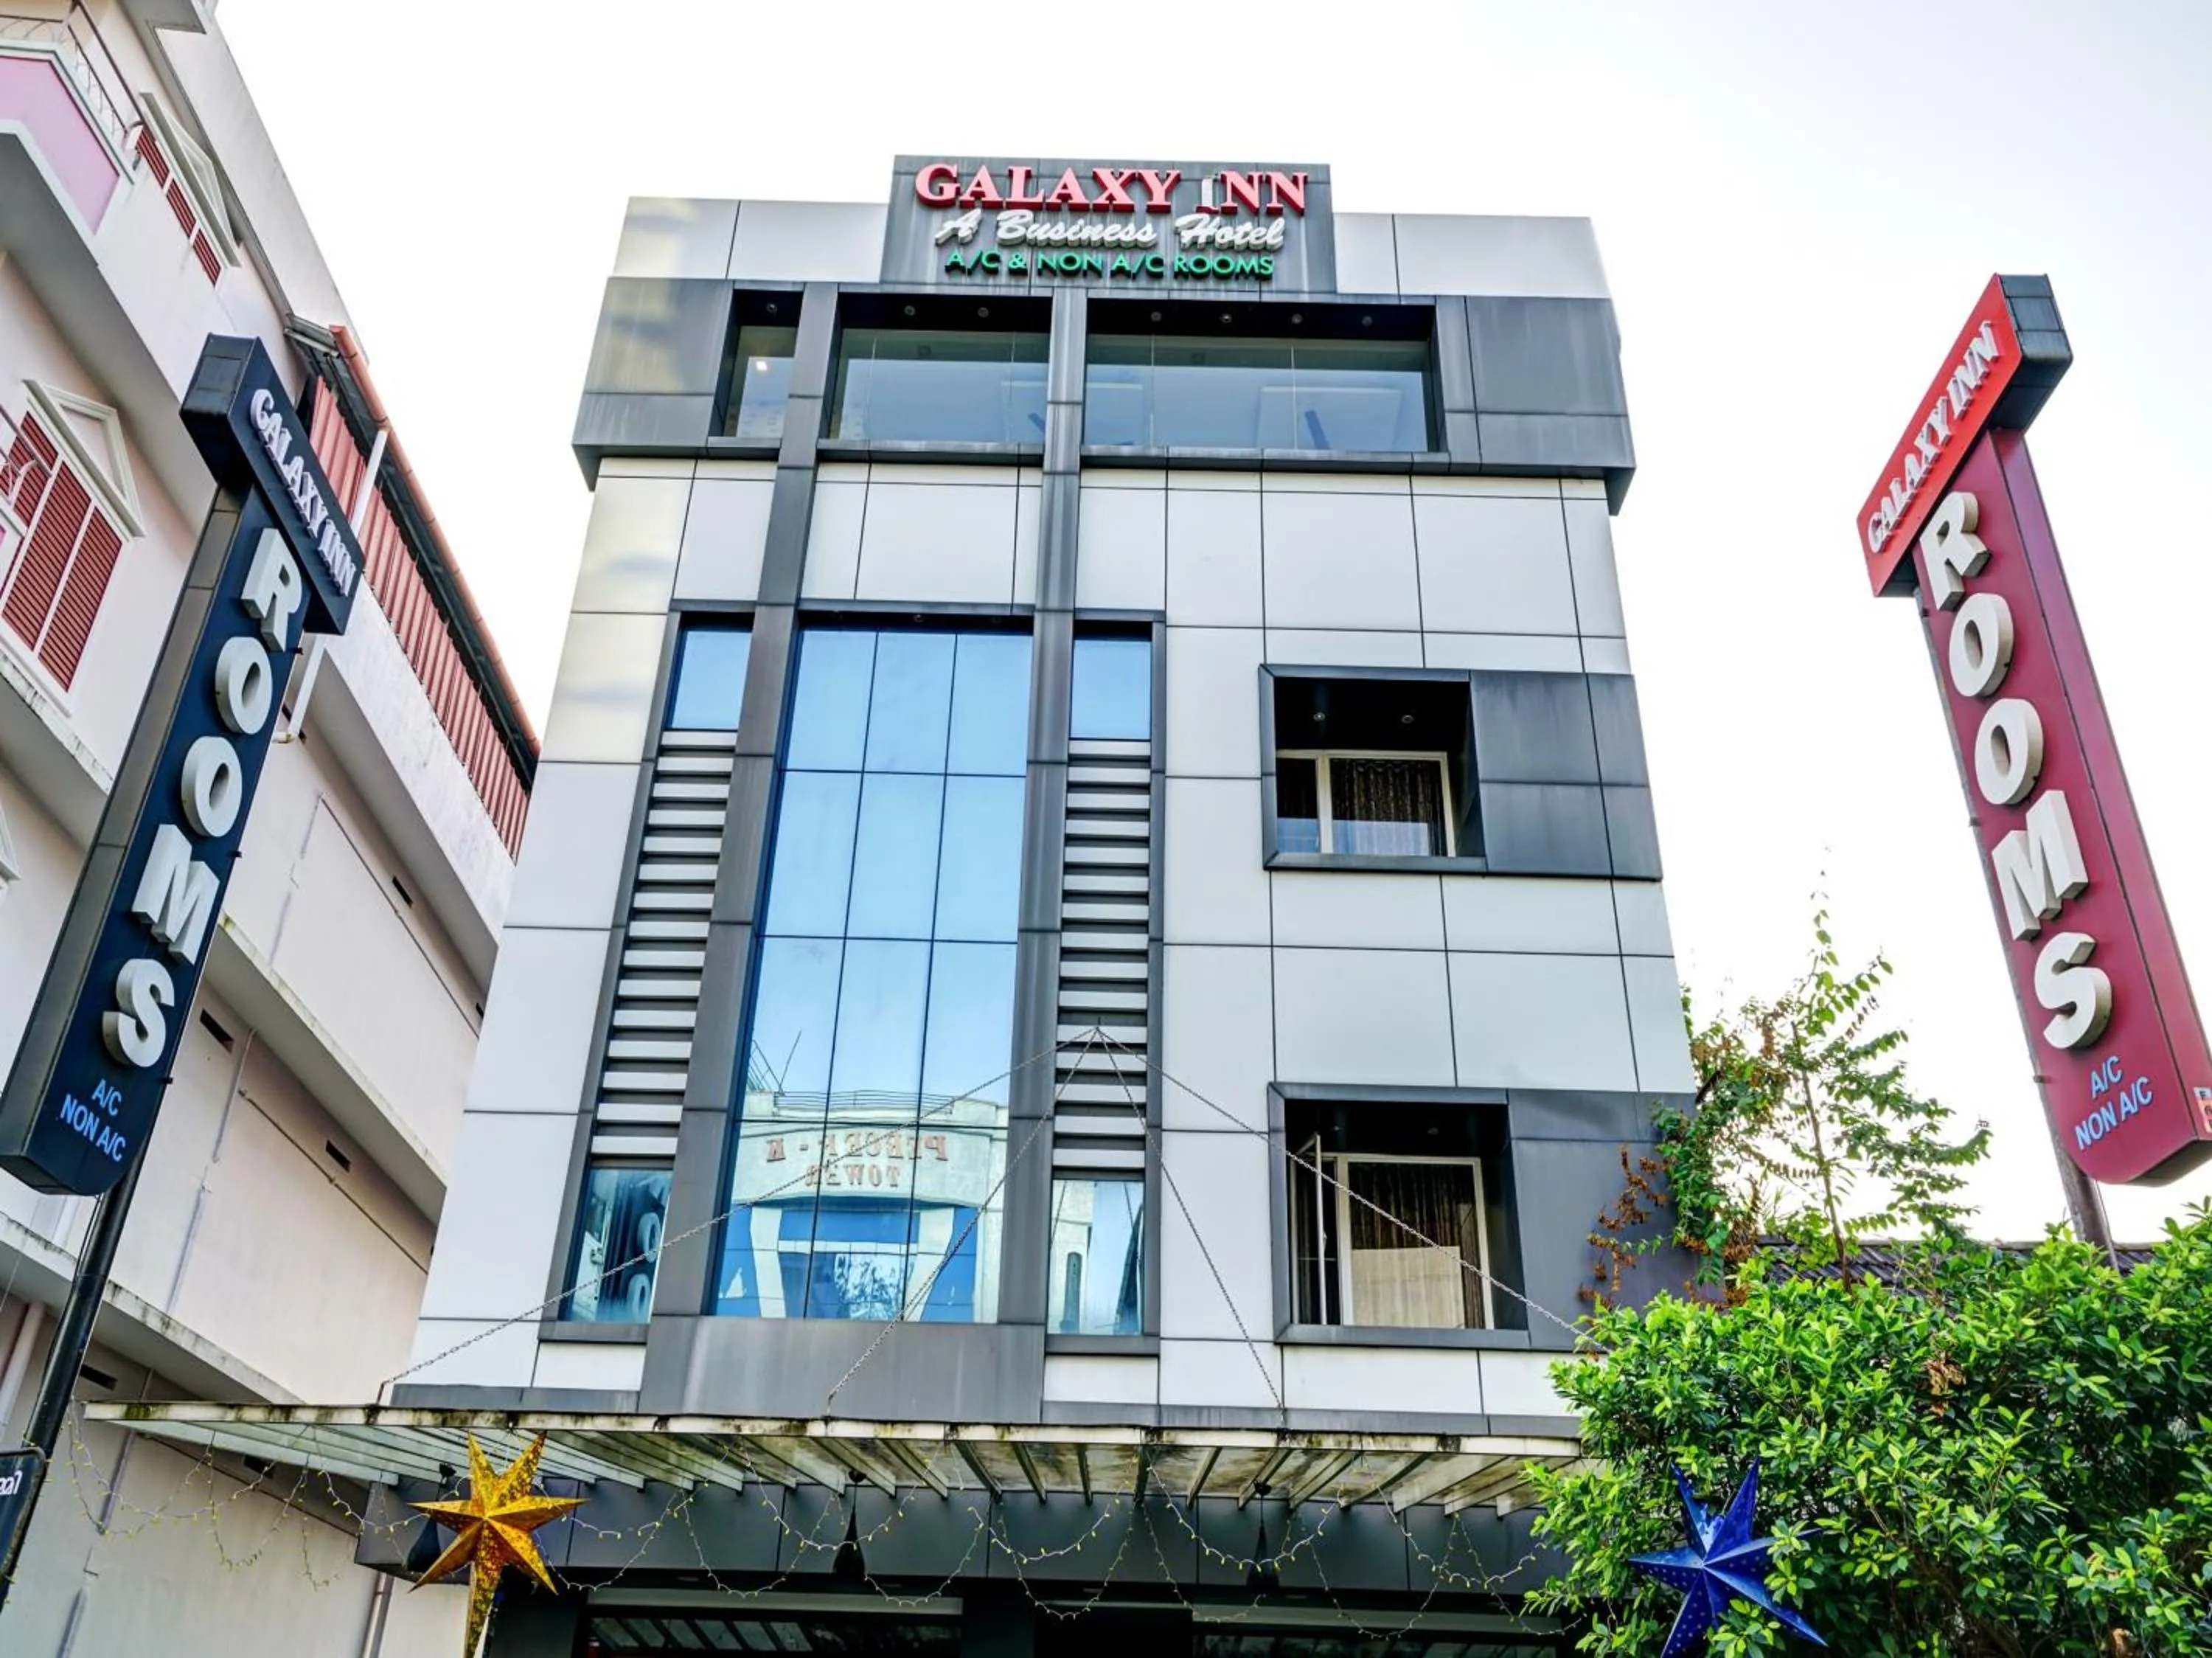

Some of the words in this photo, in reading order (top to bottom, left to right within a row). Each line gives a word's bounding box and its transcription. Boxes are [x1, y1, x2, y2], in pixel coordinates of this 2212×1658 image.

[915, 163, 1182, 213] GALAXY
[1197, 170, 1308, 216] INN
[935, 208, 984, 246] A
[997, 209, 1158, 249] Business
[1175, 212, 1285, 252] Hotel
[945, 251, 1002, 276] A/C
[1007, 254, 1027, 275] &
[1037, 255, 1103, 278] NON
[1110, 255, 1165, 279] A/C
[1174, 255, 1275, 280] ROOMS
[1868, 396, 1953, 555] GALAXY
[1947, 320, 2002, 421] INN
[249, 388, 329, 539] GALAXY
[316, 518, 357, 597] INN
[102, 527, 303, 1067] ROOMS
[1919, 491, 2112, 1050] ROOMS
[91, 1078, 122, 1117] A/C
[2090, 1055, 2123, 1098] A/C
[60, 1092, 100, 1142] NON
[95, 1125, 126, 1162] A/C
[2074, 1102, 2118, 1151] NON
[2120, 1076, 2152, 1121] A/C
